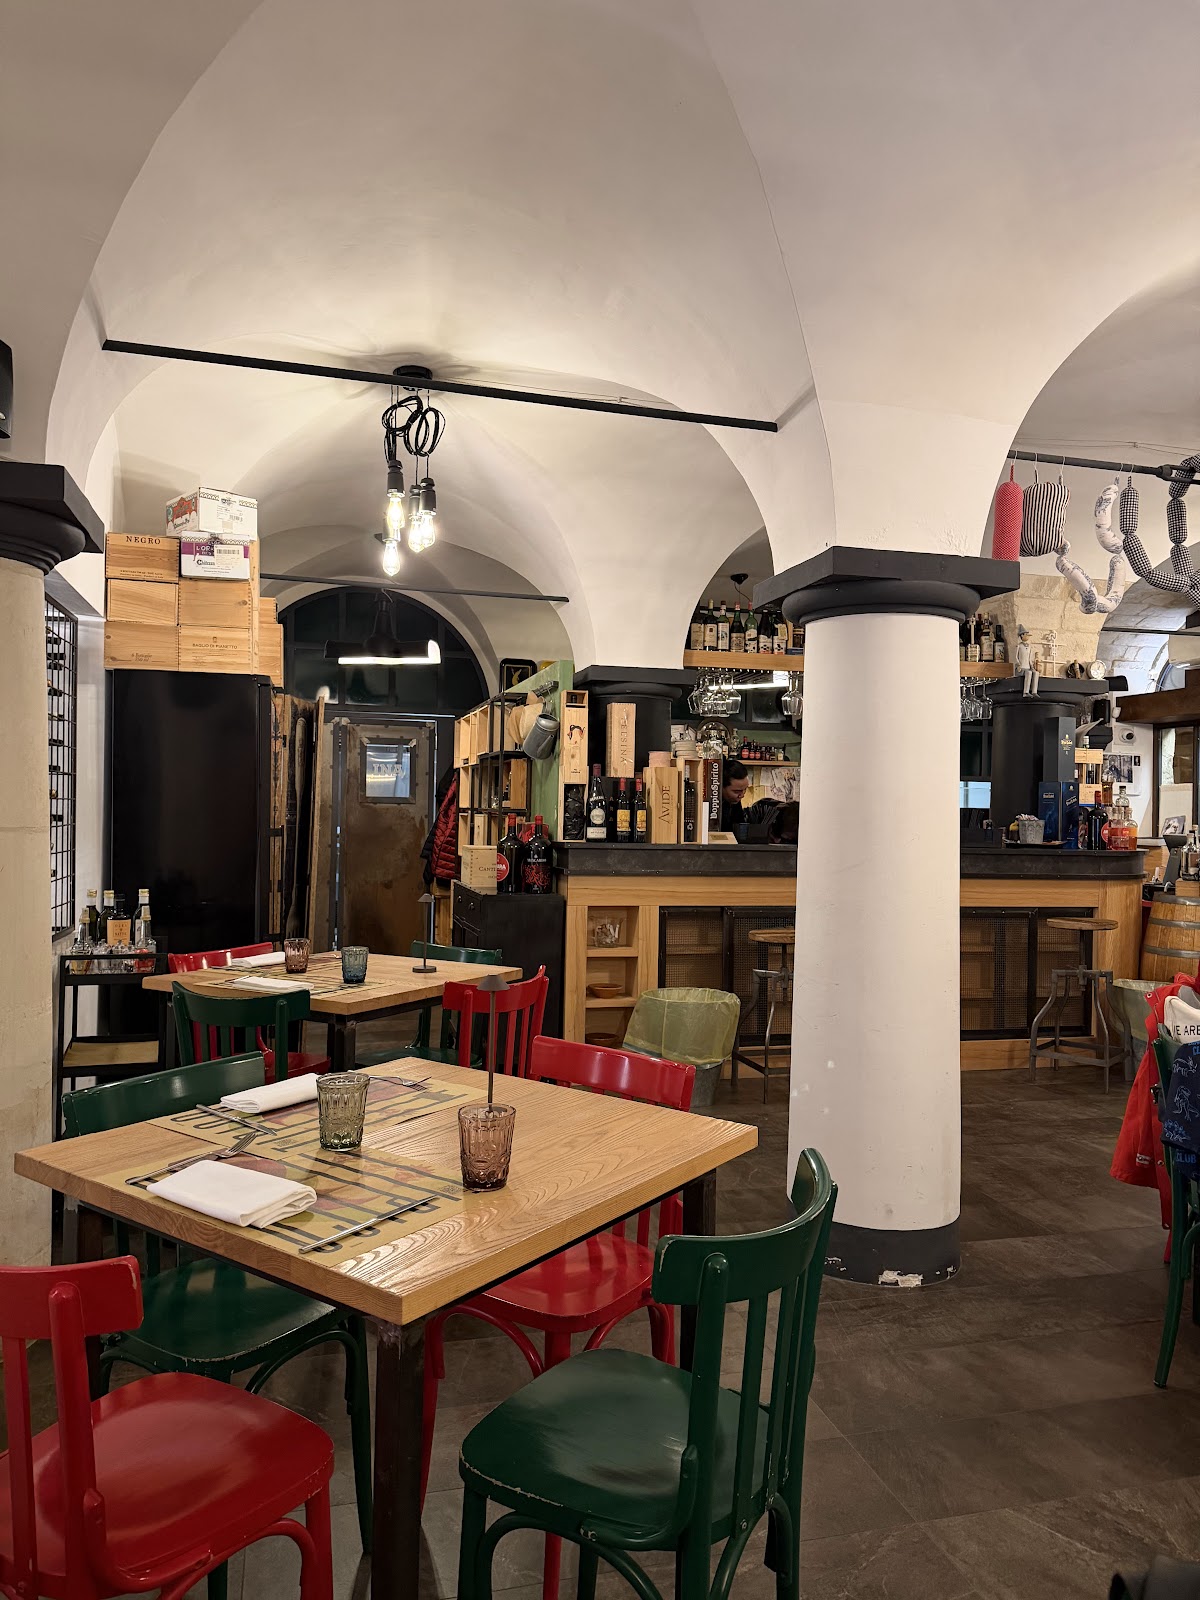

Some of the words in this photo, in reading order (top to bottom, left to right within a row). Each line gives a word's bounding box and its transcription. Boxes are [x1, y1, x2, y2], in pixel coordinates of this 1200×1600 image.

[125, 536, 161, 545] NEGRO
[658, 785, 670, 824] AVIDE
[710, 763, 720, 819] DoppioSpirito
